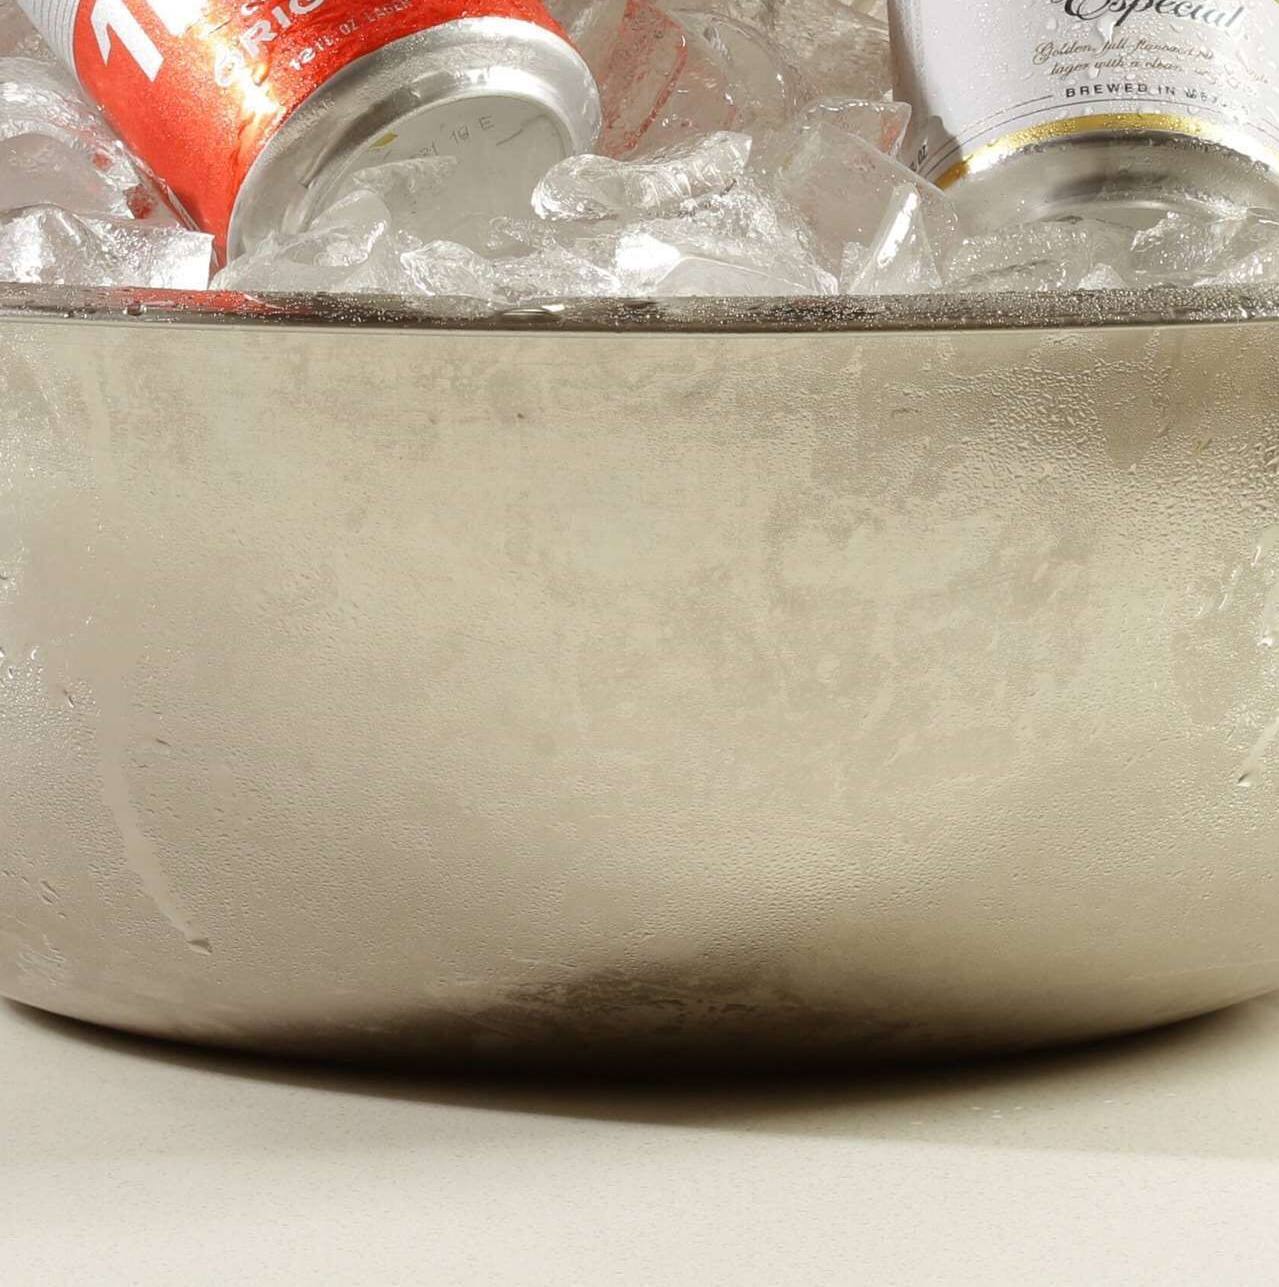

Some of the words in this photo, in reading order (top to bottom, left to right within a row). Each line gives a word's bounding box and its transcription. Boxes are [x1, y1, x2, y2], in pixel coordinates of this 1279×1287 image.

[288, 47, 317, 71] 12
[340, 18, 360, 36] OZ
[1050, 59, 1090, 81] lager
[1093, 56, 1125, 74] with
[1130, 60, 1143, 70] a
[1064, 82, 1149, 99] BREWED
[1157, 85, 1176, 97] IN
